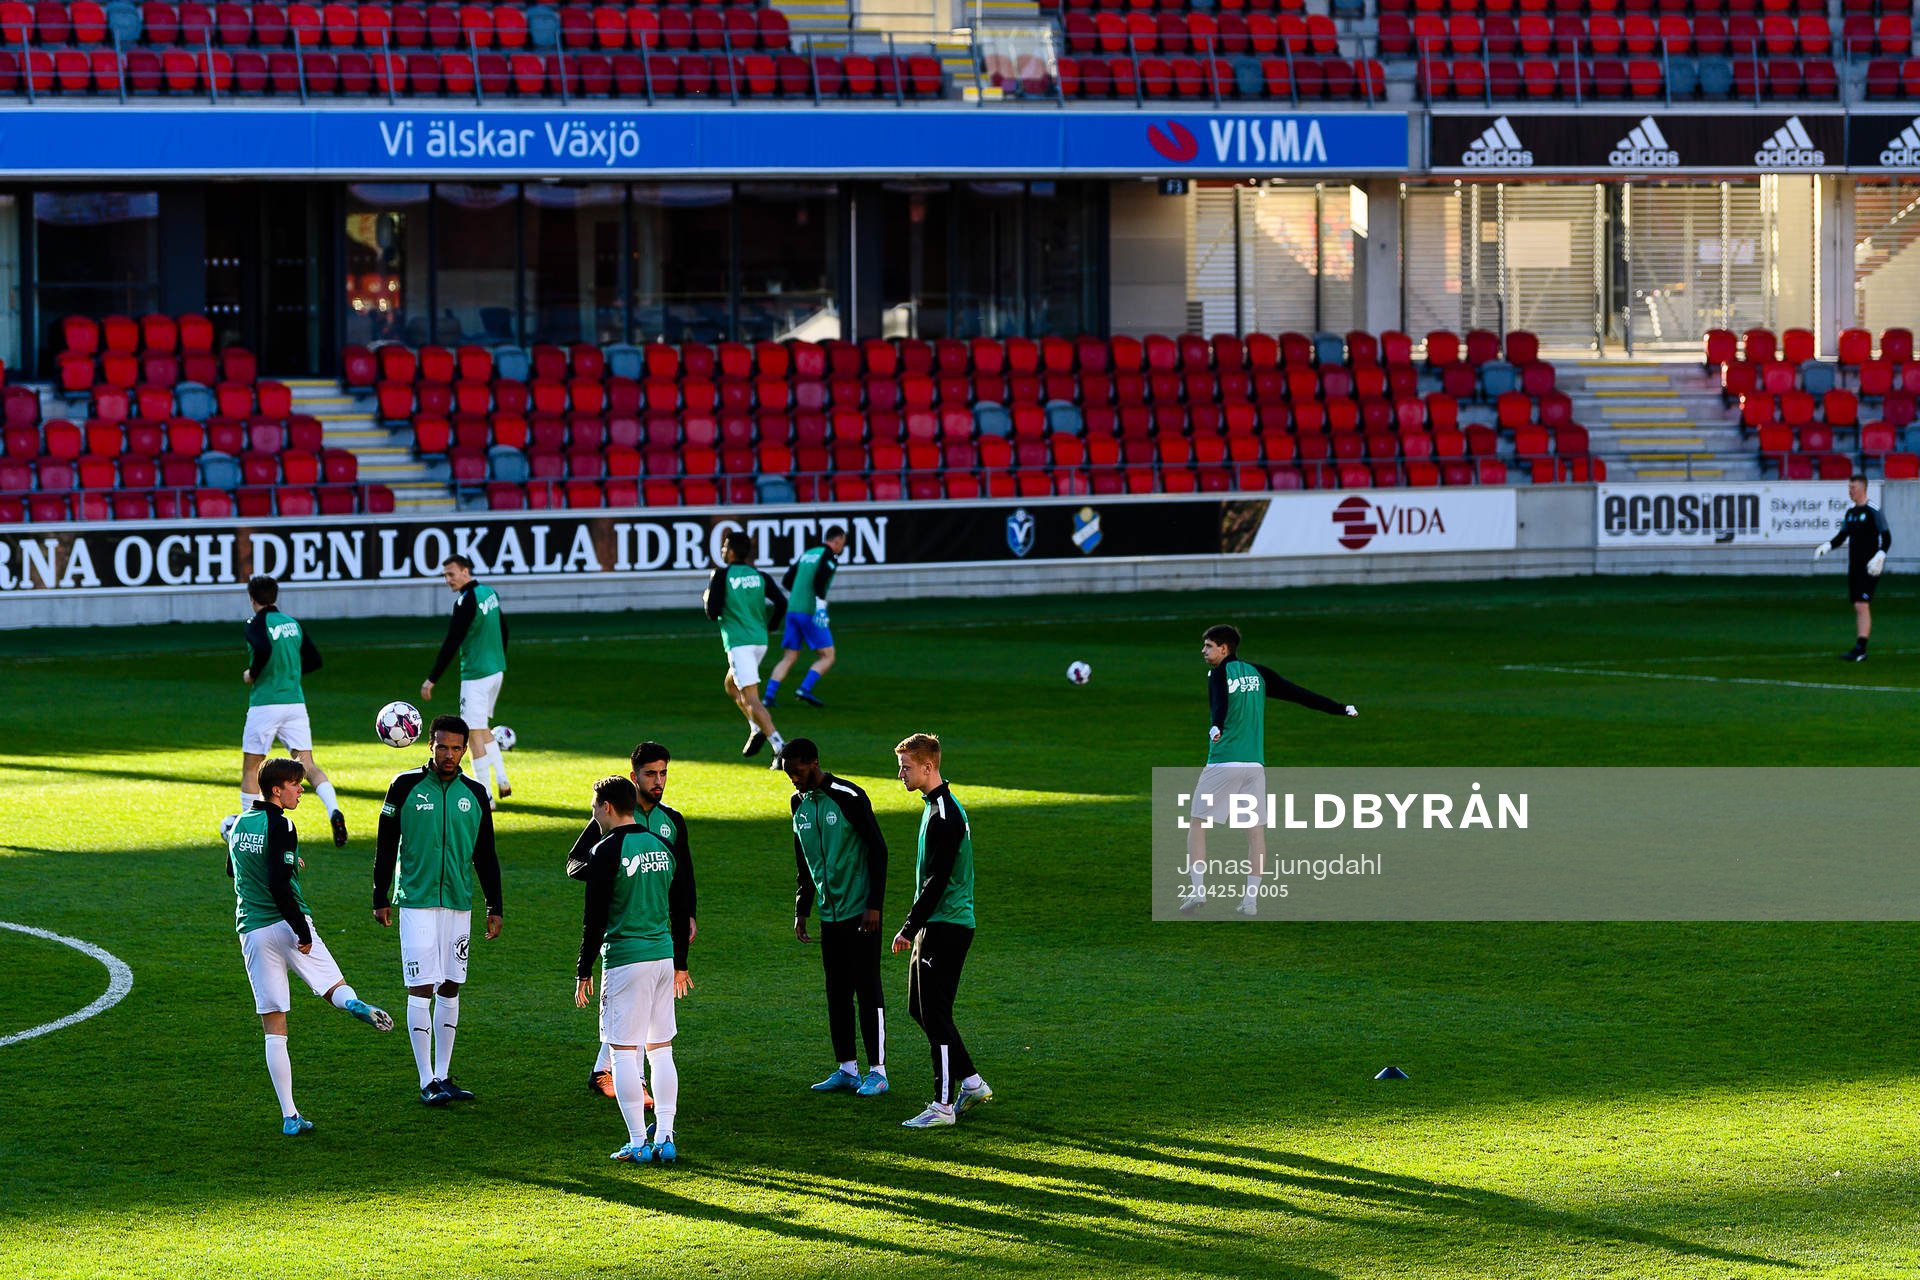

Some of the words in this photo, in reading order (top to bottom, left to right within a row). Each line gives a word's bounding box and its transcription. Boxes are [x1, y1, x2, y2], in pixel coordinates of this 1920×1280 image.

[379, 120, 413, 157] Vi
[426, 120, 535, 157] älskar
[545, 121, 640, 166] Växjö
[1209, 119, 1328, 162] VISMA
[1462, 149, 1534, 167] adidas
[1608, 149, 1680, 167] adidas
[1754, 149, 1825, 167] adidas
[1376, 505, 1446, 535] VIDA
[1604, 493, 1760, 543] ecosign
[114, 534, 236, 586] OCH
[249, 530, 365, 581] DEN
[378, 524, 603, 578] LOKALA
[239, 841, 264, 854] SPORT
[240, 832, 265, 845] INTER
[640, 851, 669, 863] INTER
[641, 861, 670, 873] SPORT
